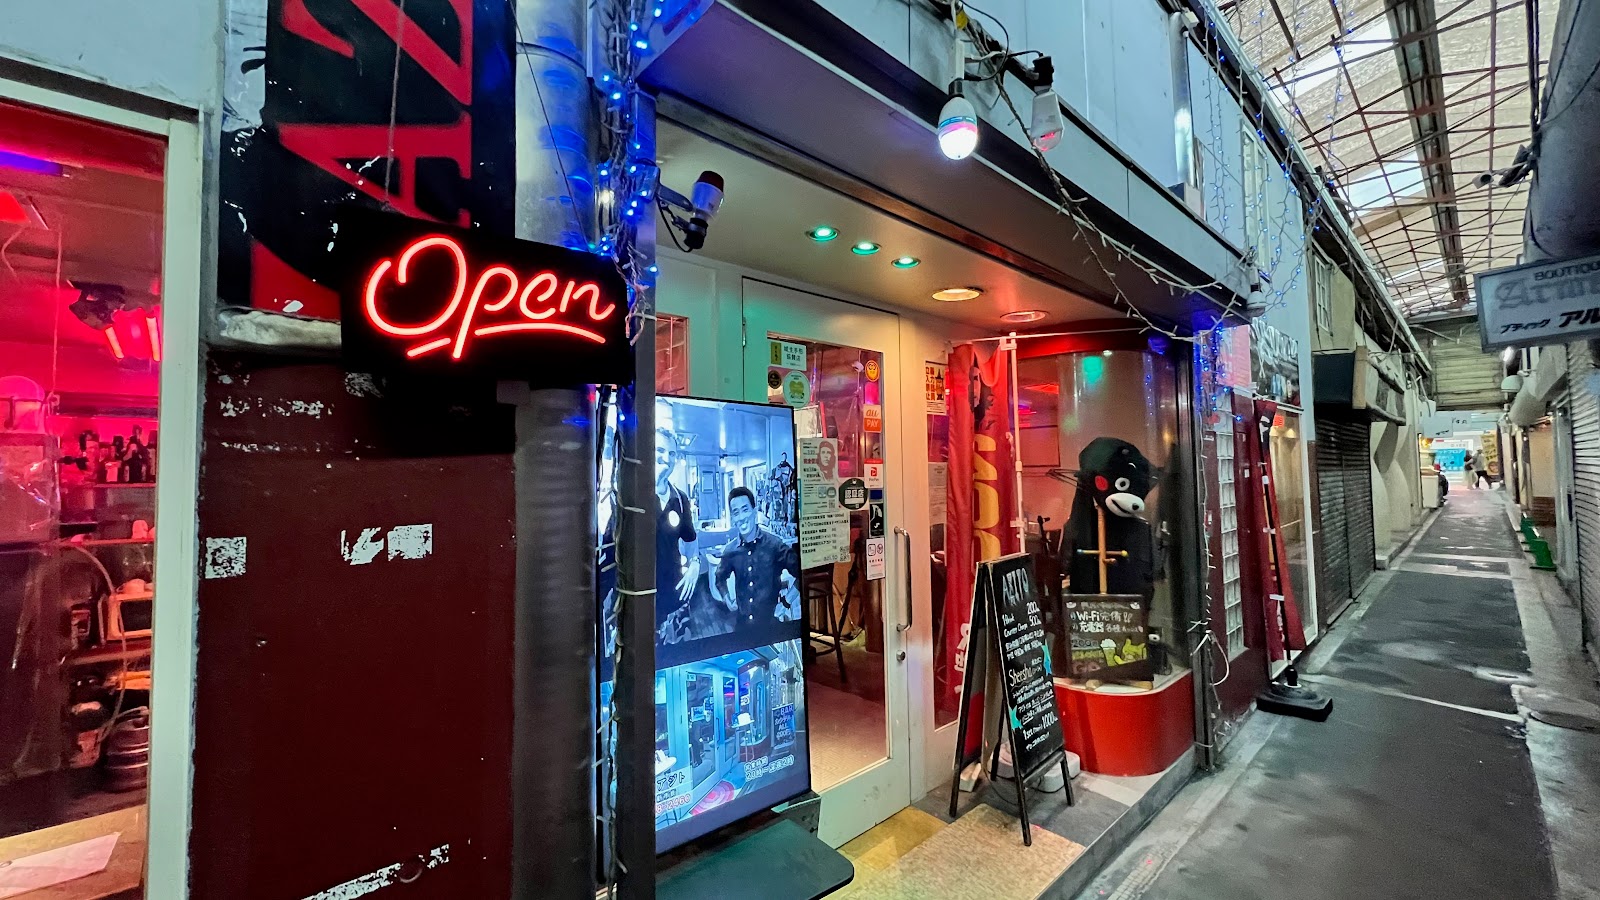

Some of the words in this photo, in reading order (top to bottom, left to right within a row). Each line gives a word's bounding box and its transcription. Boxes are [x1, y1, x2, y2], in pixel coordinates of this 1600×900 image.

[364, 236, 617, 360] Open
[865, 408, 879, 417] au
[866, 418, 879, 428] PAY
